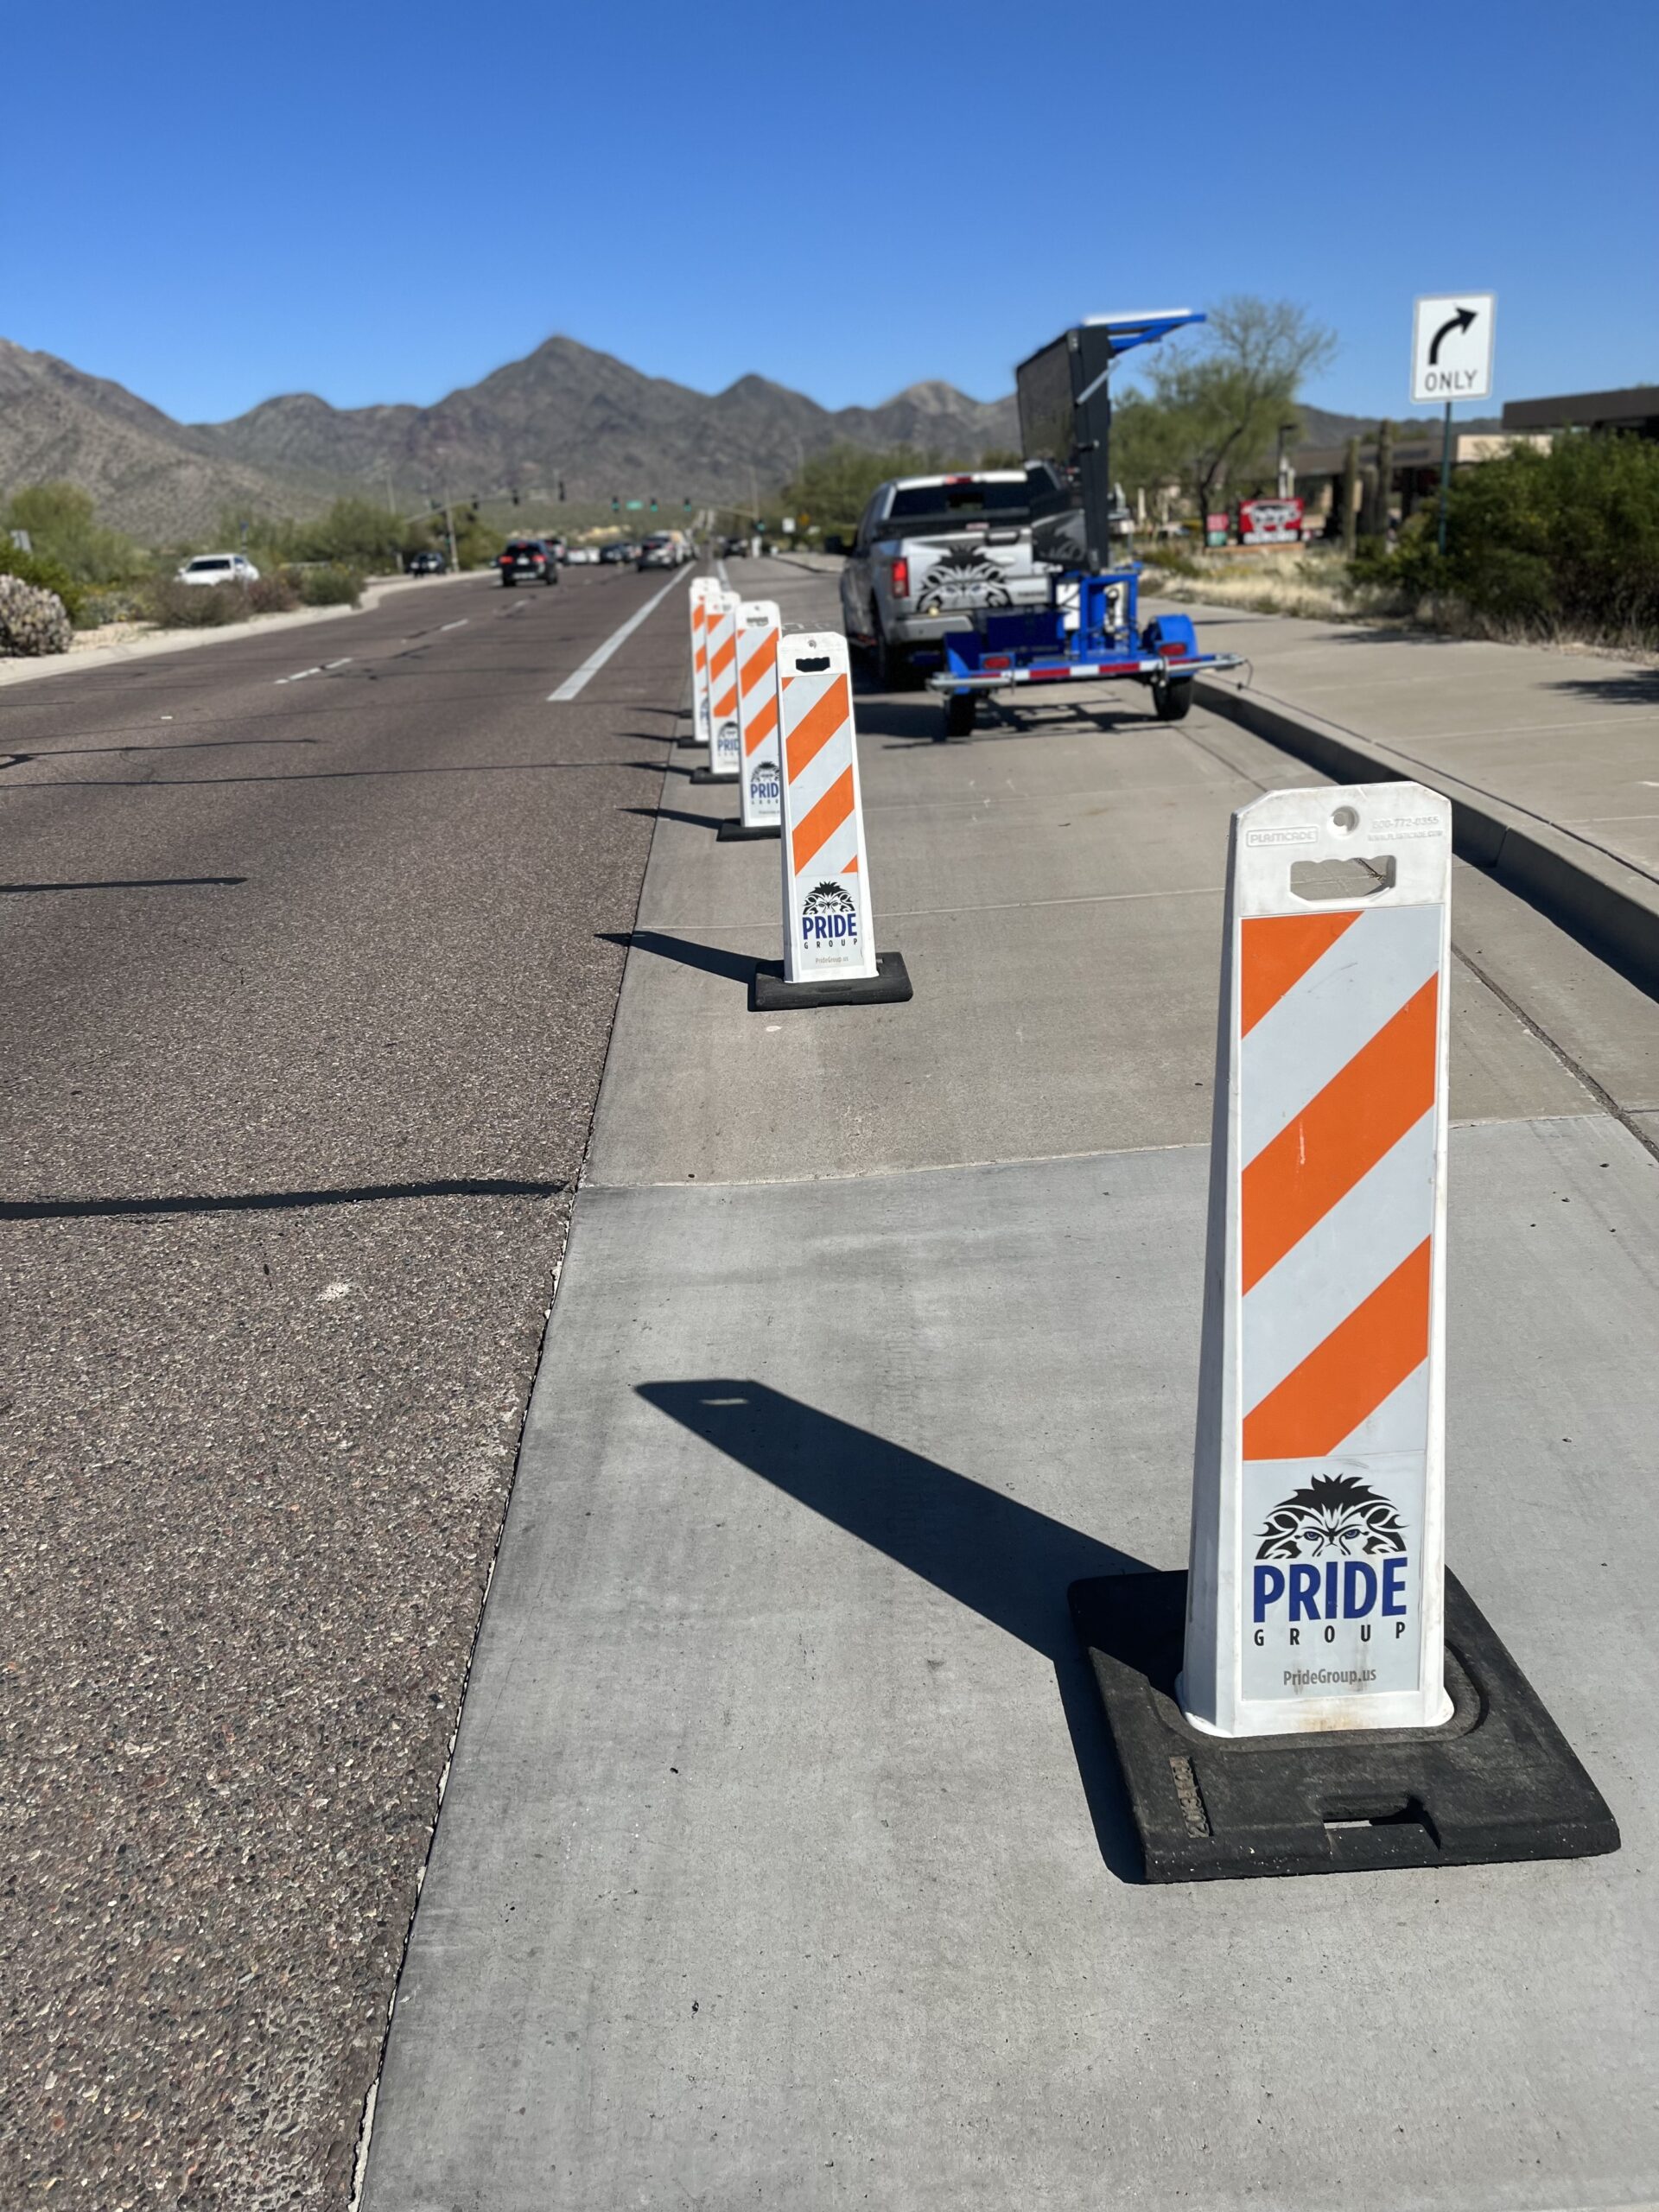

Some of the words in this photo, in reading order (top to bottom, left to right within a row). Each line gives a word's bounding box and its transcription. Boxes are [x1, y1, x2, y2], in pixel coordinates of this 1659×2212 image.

[1425, 369, 1478, 392] ONLY
[717, 739, 740, 751] PRID
[750, 782, 779, 798] PRID
[1249, 831, 1315, 842] PLASTICADE
[802, 913, 858, 940] PRIDE
[804, 938, 858, 950] GROUP
[1253, 1557, 1408, 1624] PRIDE
[1254, 1622, 1406, 1647] GROUP
[1283, 1669, 1377, 1686] PrideGroup.us
